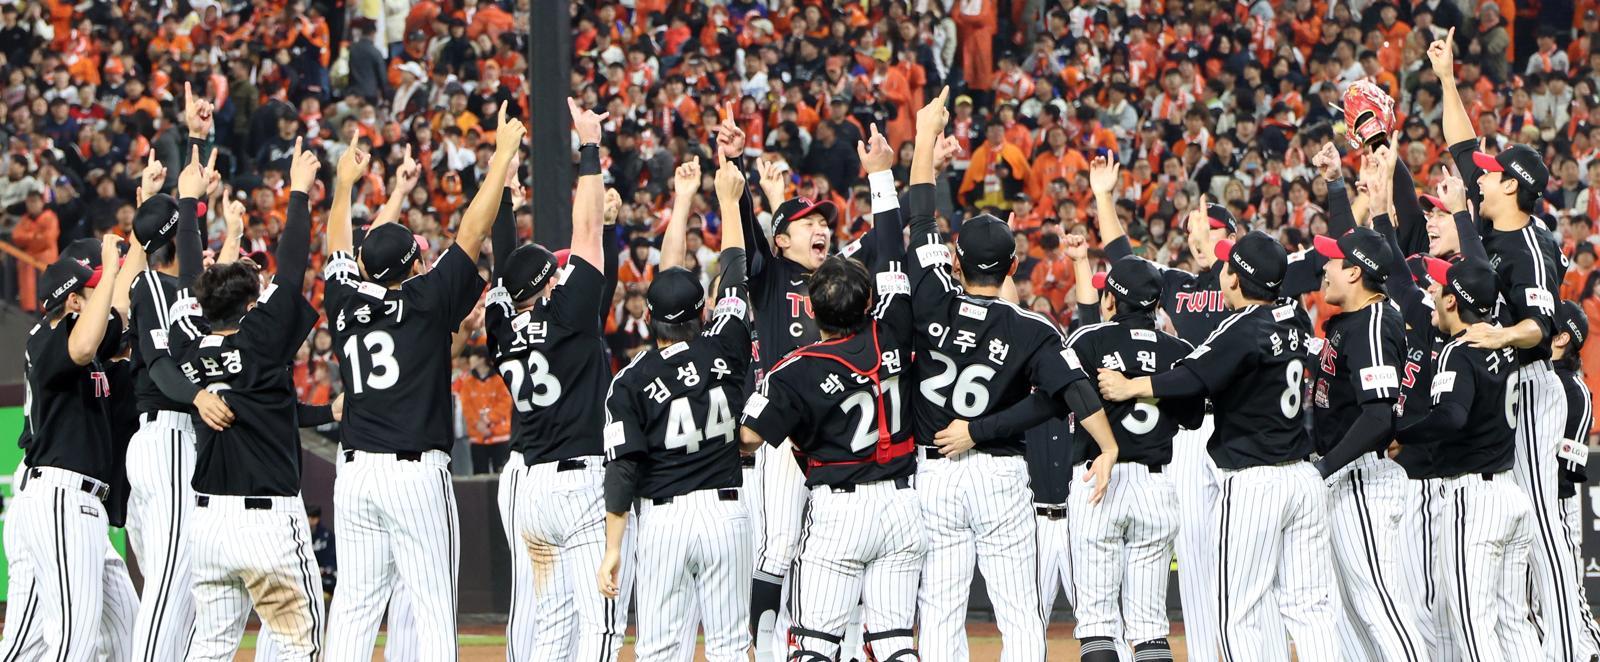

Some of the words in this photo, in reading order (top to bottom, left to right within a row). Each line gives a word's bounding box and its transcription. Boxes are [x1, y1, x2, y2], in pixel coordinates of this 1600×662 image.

[1511, 161, 1535, 185] LGE.COM
[531, 260, 552, 286] LGE.COM
[1352, 248, 1379, 271] LGE.COM
[53, 276, 78, 299] LGE.COM
[1452, 278, 1475, 305] LGE.COM
[496, 320, 548, 358] 스틴
[928, 322, 1009, 365] 이주헌
[343, 329, 400, 394] 13
[499, 350, 562, 412] 23
[919, 350, 997, 418] 26
[1280, 359, 1303, 419] 8
[665, 385, 736, 454] 44
[840, 375, 901, 454] 27
